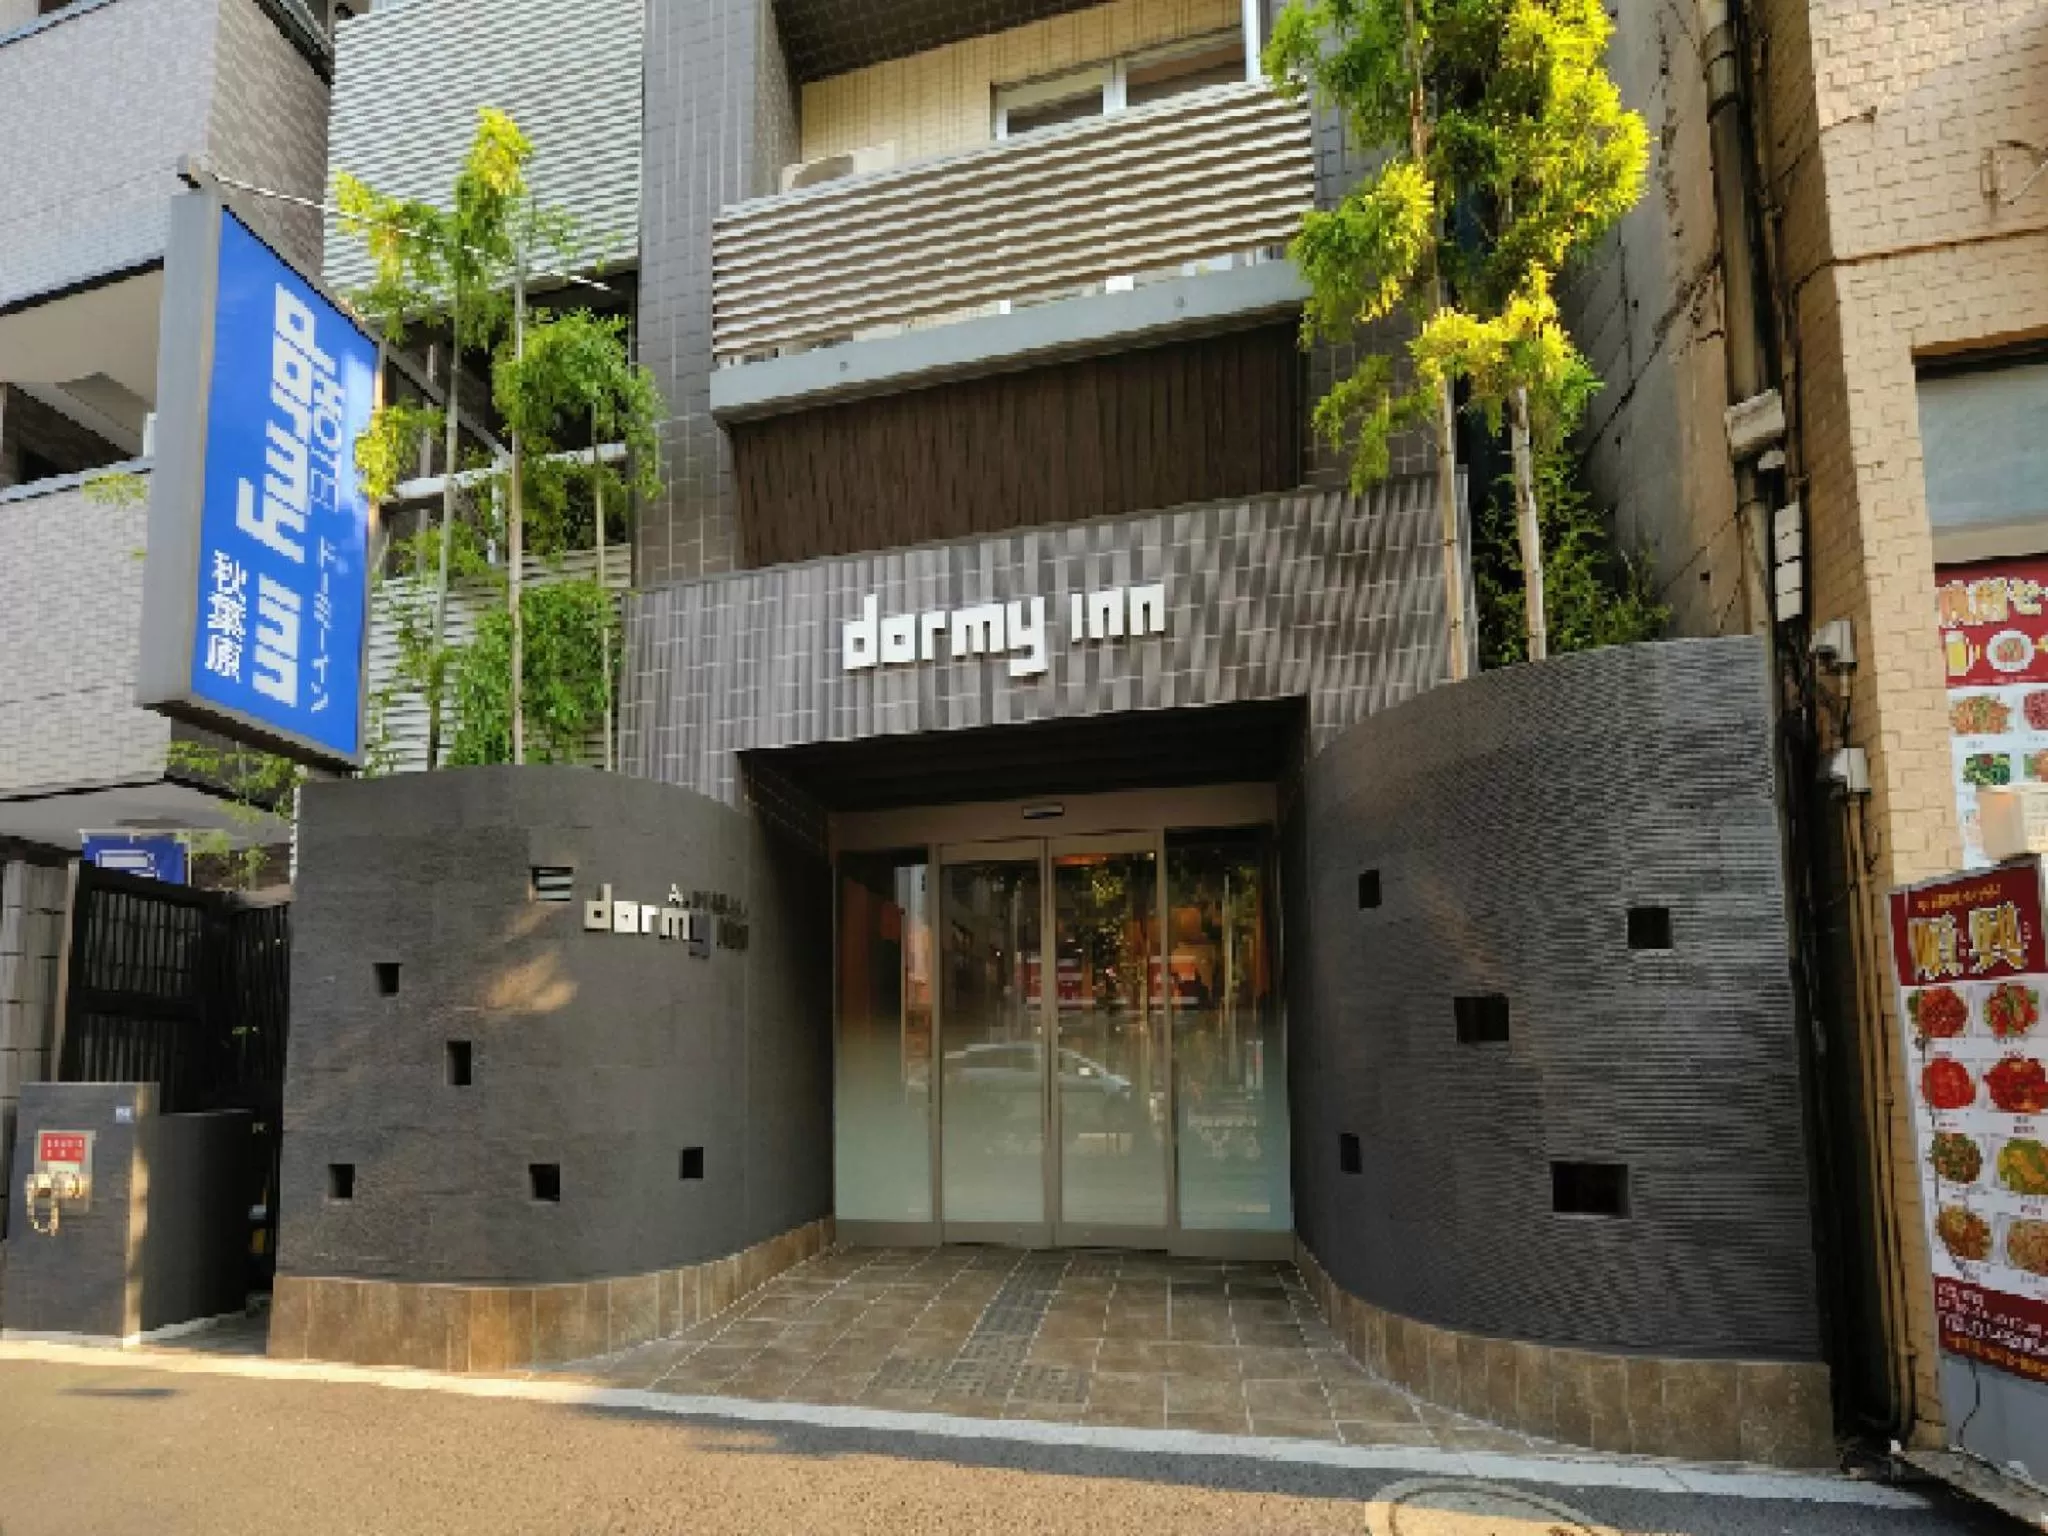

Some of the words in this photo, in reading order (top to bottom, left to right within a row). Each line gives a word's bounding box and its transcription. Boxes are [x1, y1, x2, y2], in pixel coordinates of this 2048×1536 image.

[236, 282, 336, 564] dormy
[252, 571, 302, 709] inn
[842, 592, 1049, 677] dormy
[1070, 583, 1165, 643] inn
